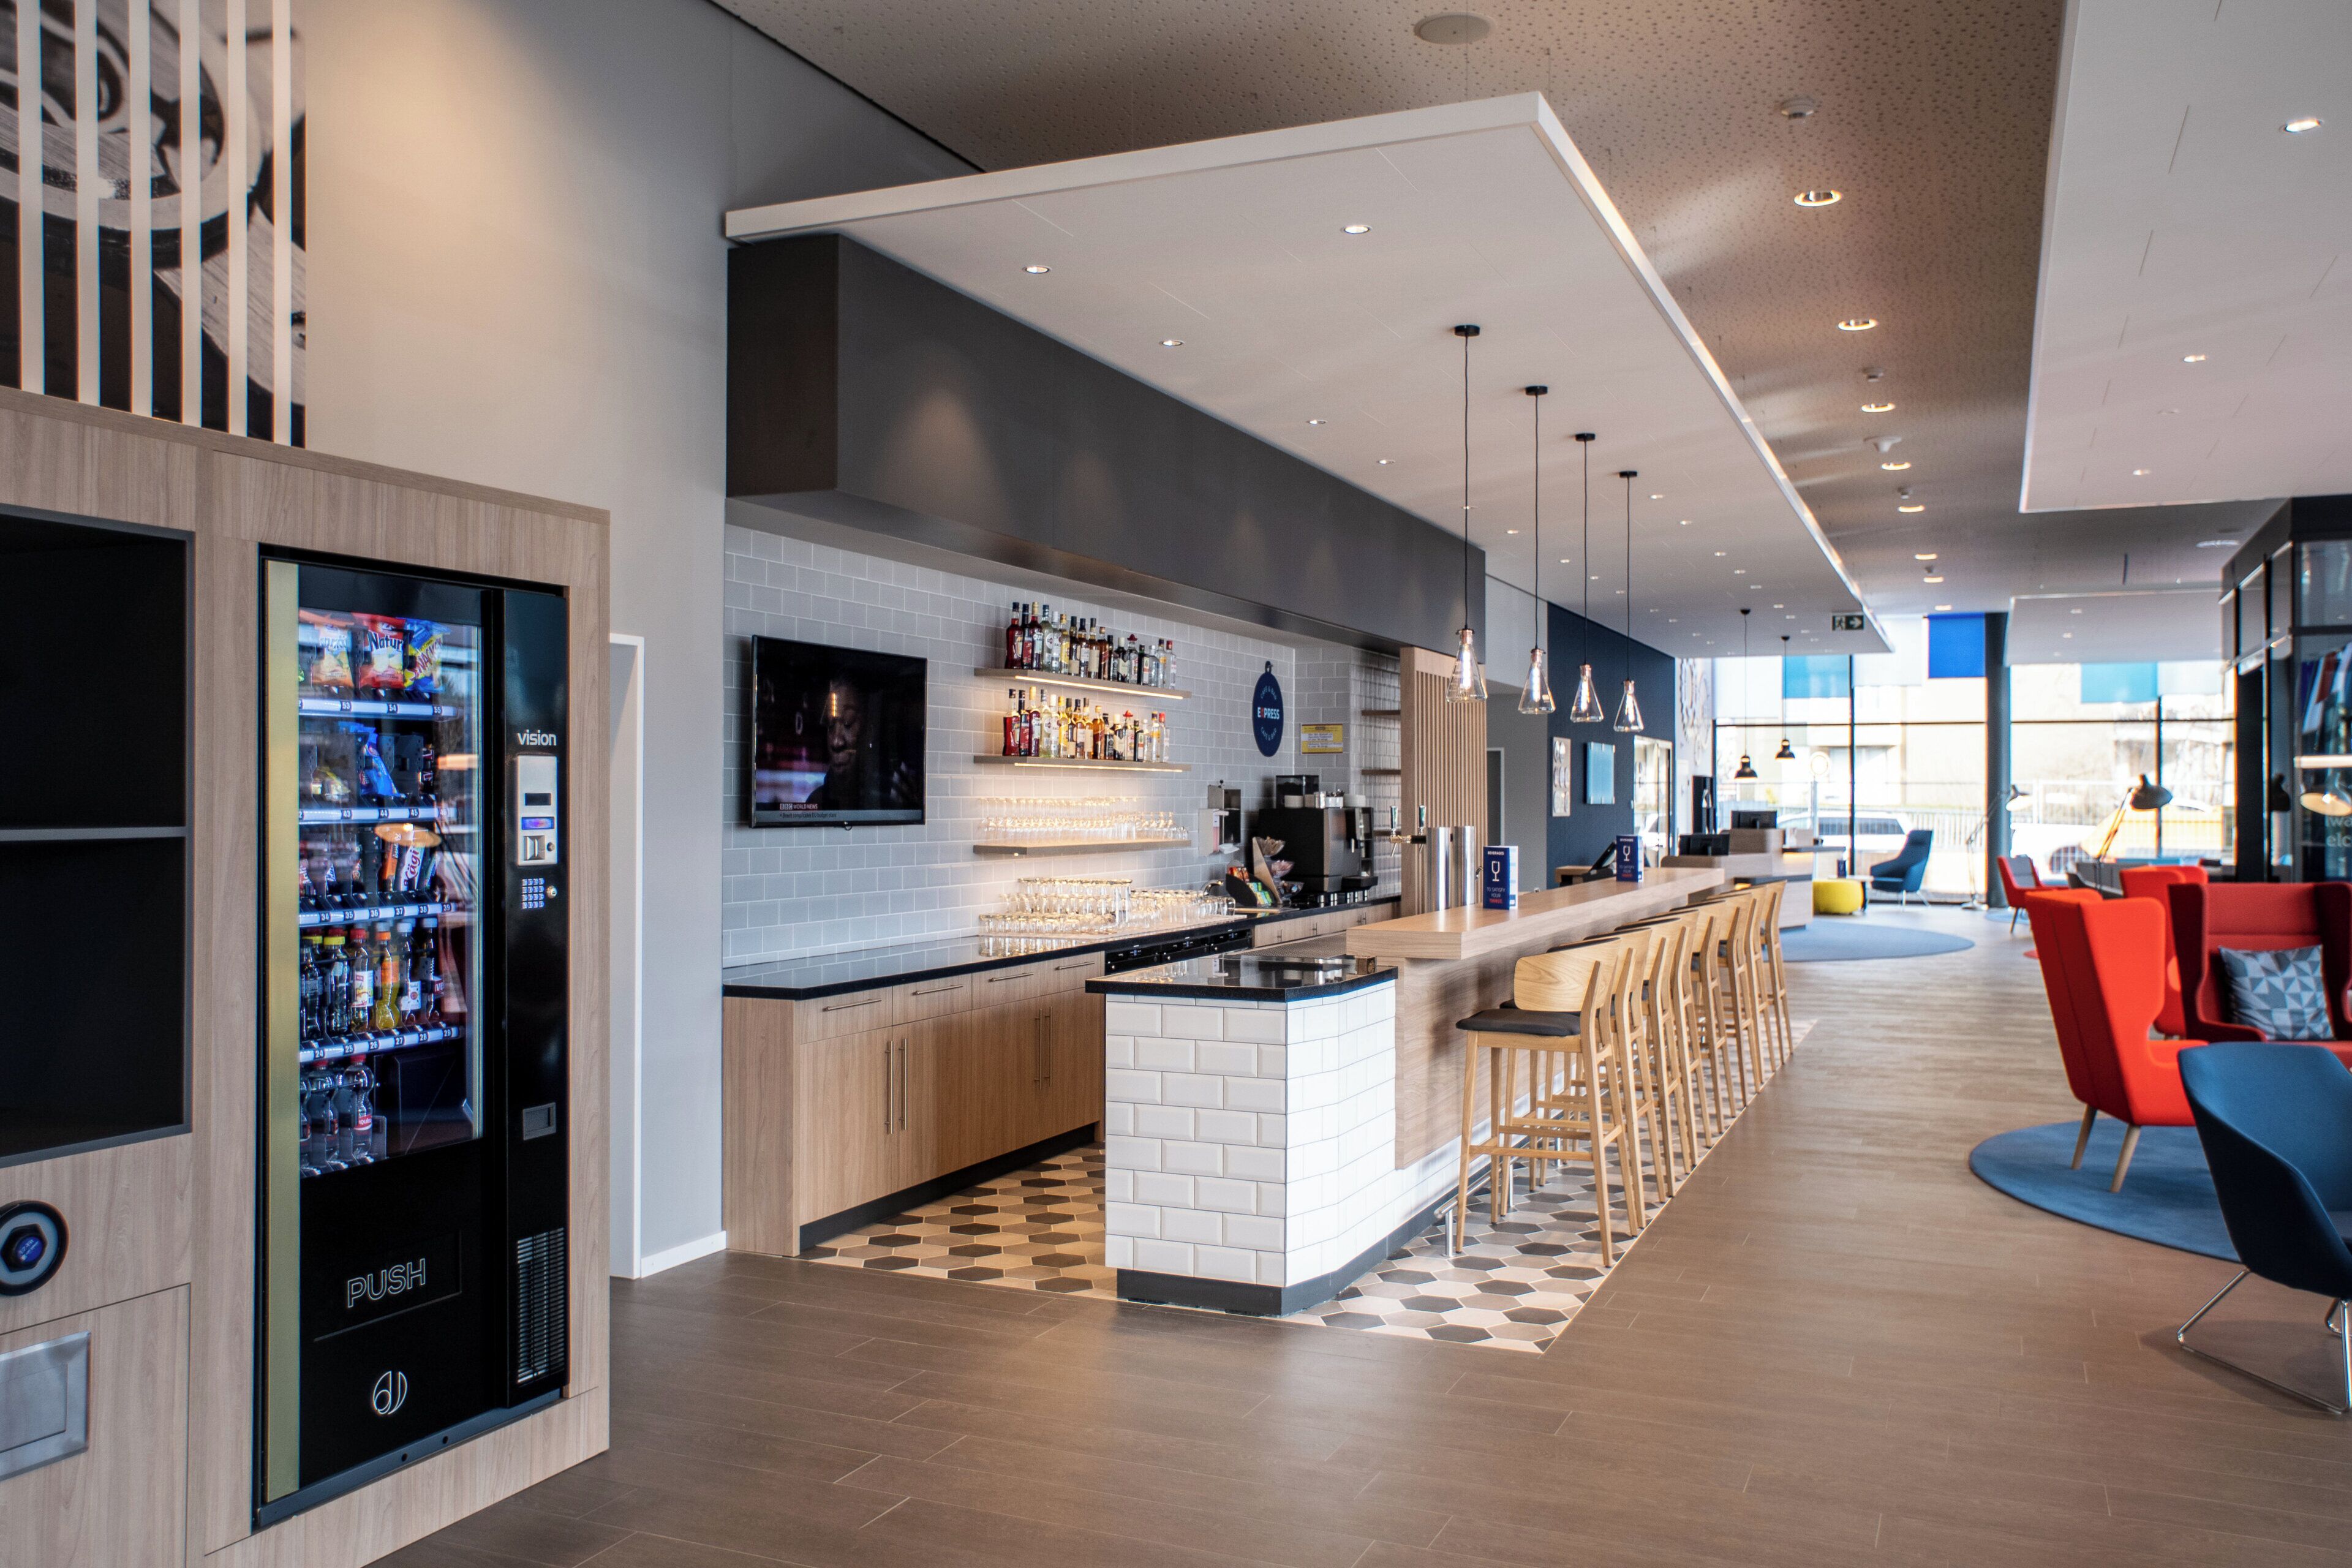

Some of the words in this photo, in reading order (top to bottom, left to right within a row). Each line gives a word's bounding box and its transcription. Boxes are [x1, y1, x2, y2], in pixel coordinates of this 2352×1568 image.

[342, 701, 350, 709] 53
[1257, 707, 1280, 720] EXPRESS
[517, 729, 557, 745] vision
[404, 849, 421, 886] Kägi
[320, 913, 330, 921] 34
[345, 911, 353, 919] 35
[370, 908, 379, 918] 36
[315, 1050, 324, 1058] 24
[369, 1041, 378, 1049] 26
[395, 1037, 404, 1046] 27
[347, 1257, 426, 1308] PUSH
